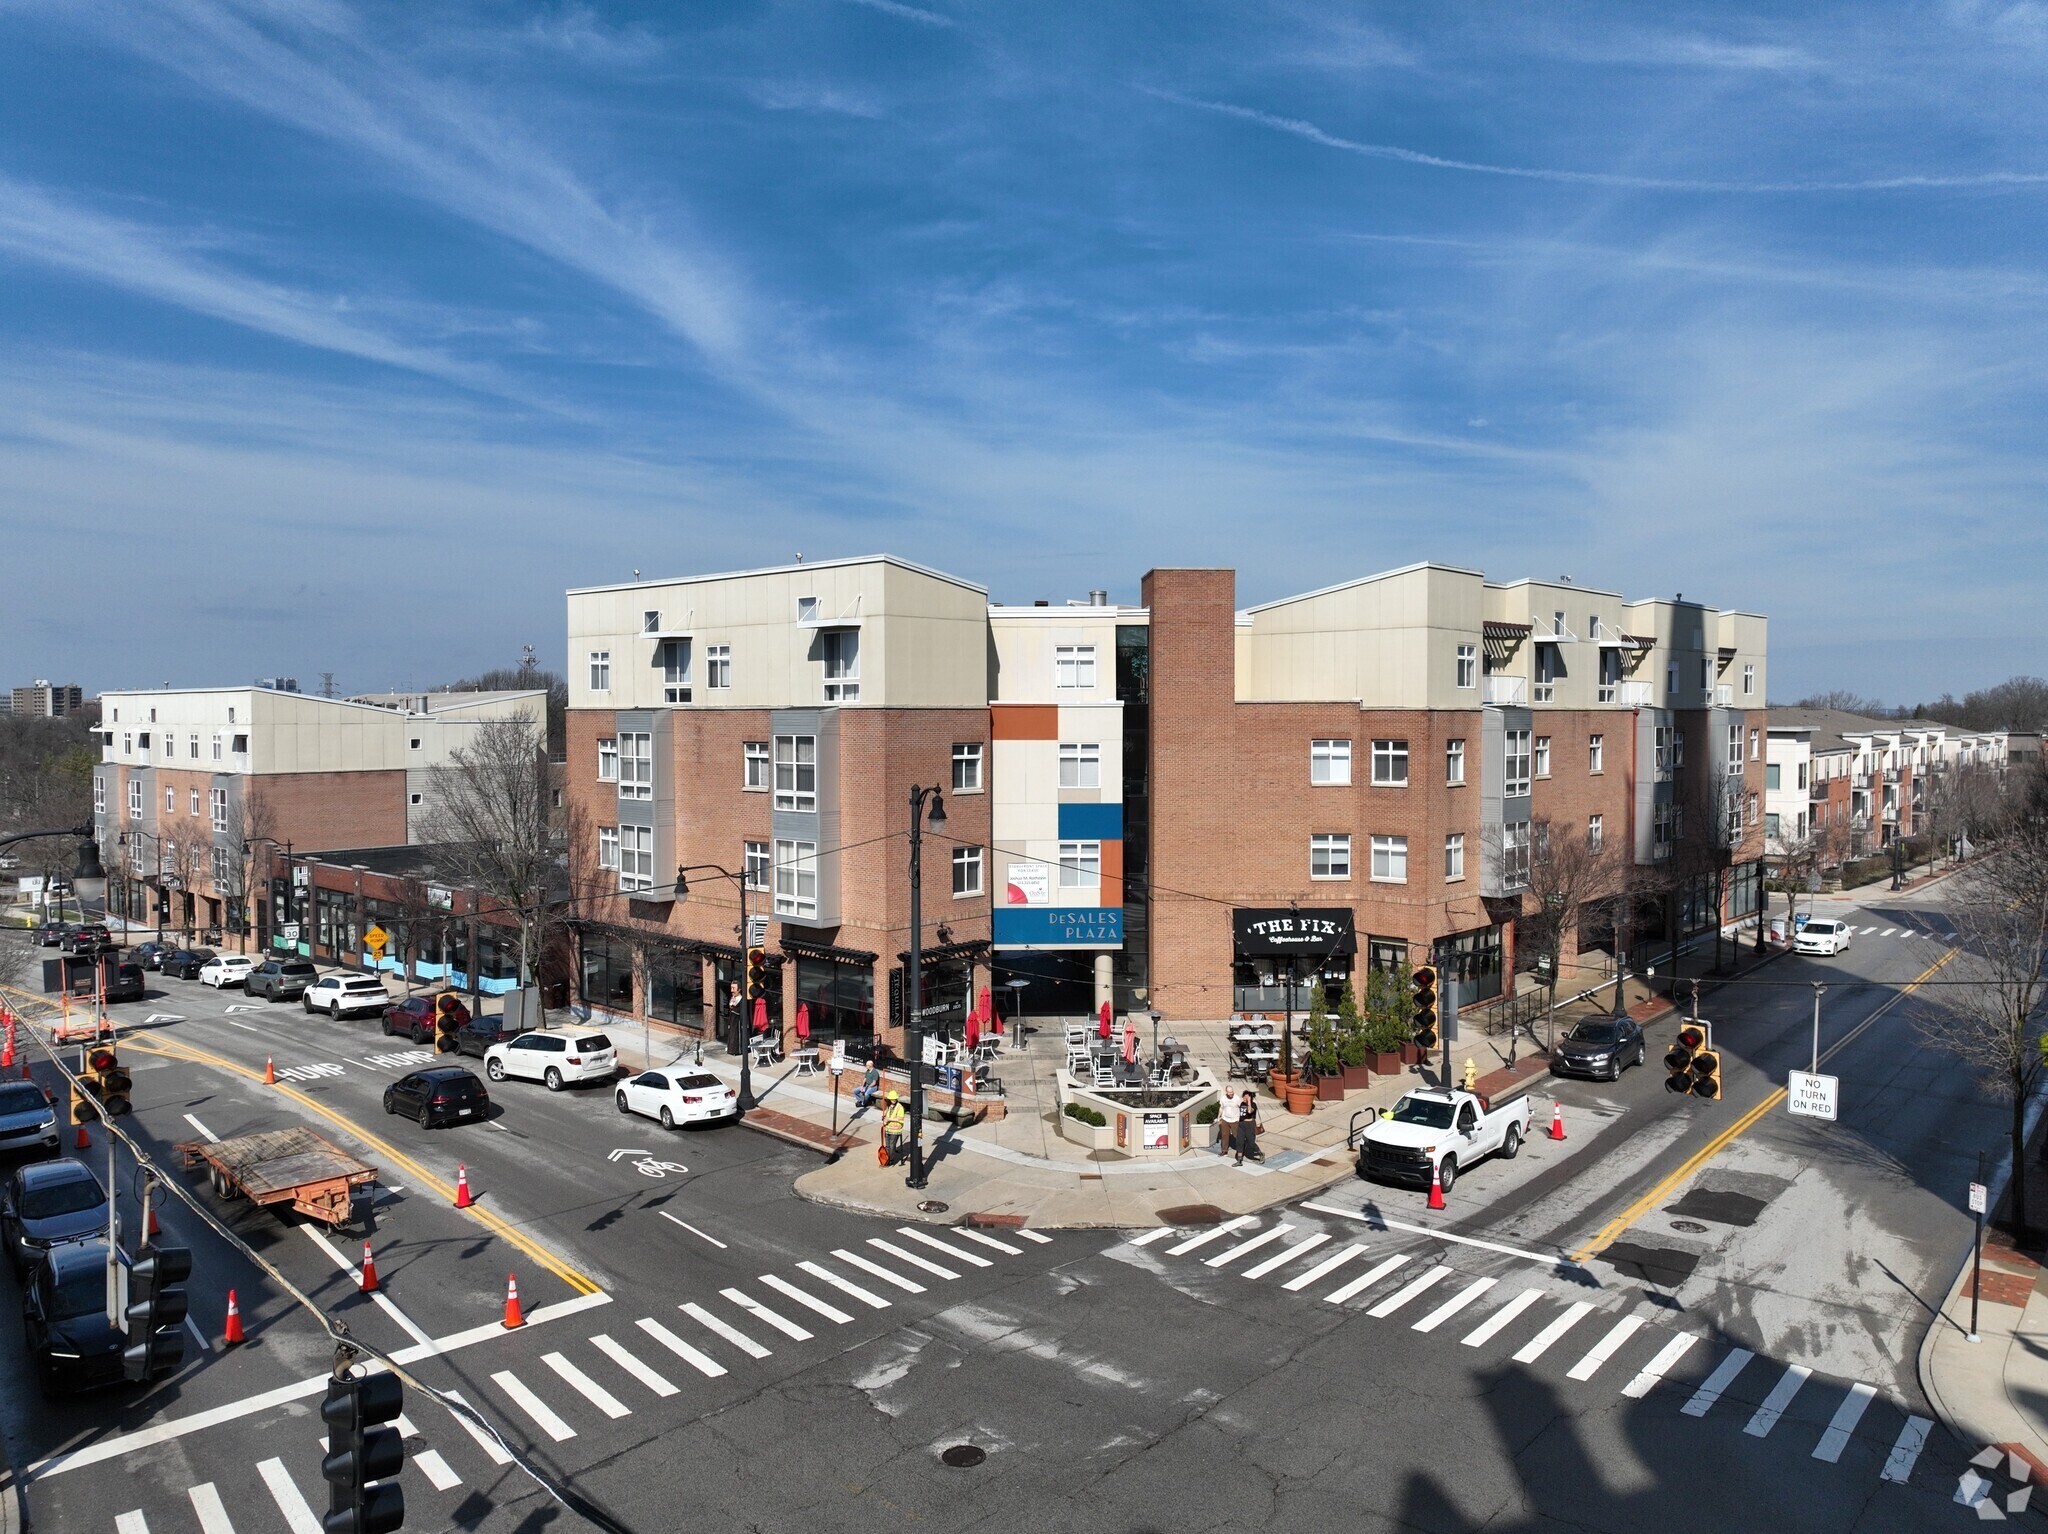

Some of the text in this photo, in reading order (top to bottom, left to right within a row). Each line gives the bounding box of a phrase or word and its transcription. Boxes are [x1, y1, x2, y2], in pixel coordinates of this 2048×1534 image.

[1066, 927, 1117, 938] PLAZA
[1253, 919, 1336, 934] THE FIX
[1268, 936, 1304, 944] Coffeehouse
[922, 1004, 950, 1016] WOODBURN
[364, 1051, 437, 1068] HUMP
[274, 1062, 346, 1082] HUMP
[1806, 1079, 1820, 1088] NO
[1800, 1090, 1826, 1100] TURN
[1794, 1100, 1831, 1113] ON RED
